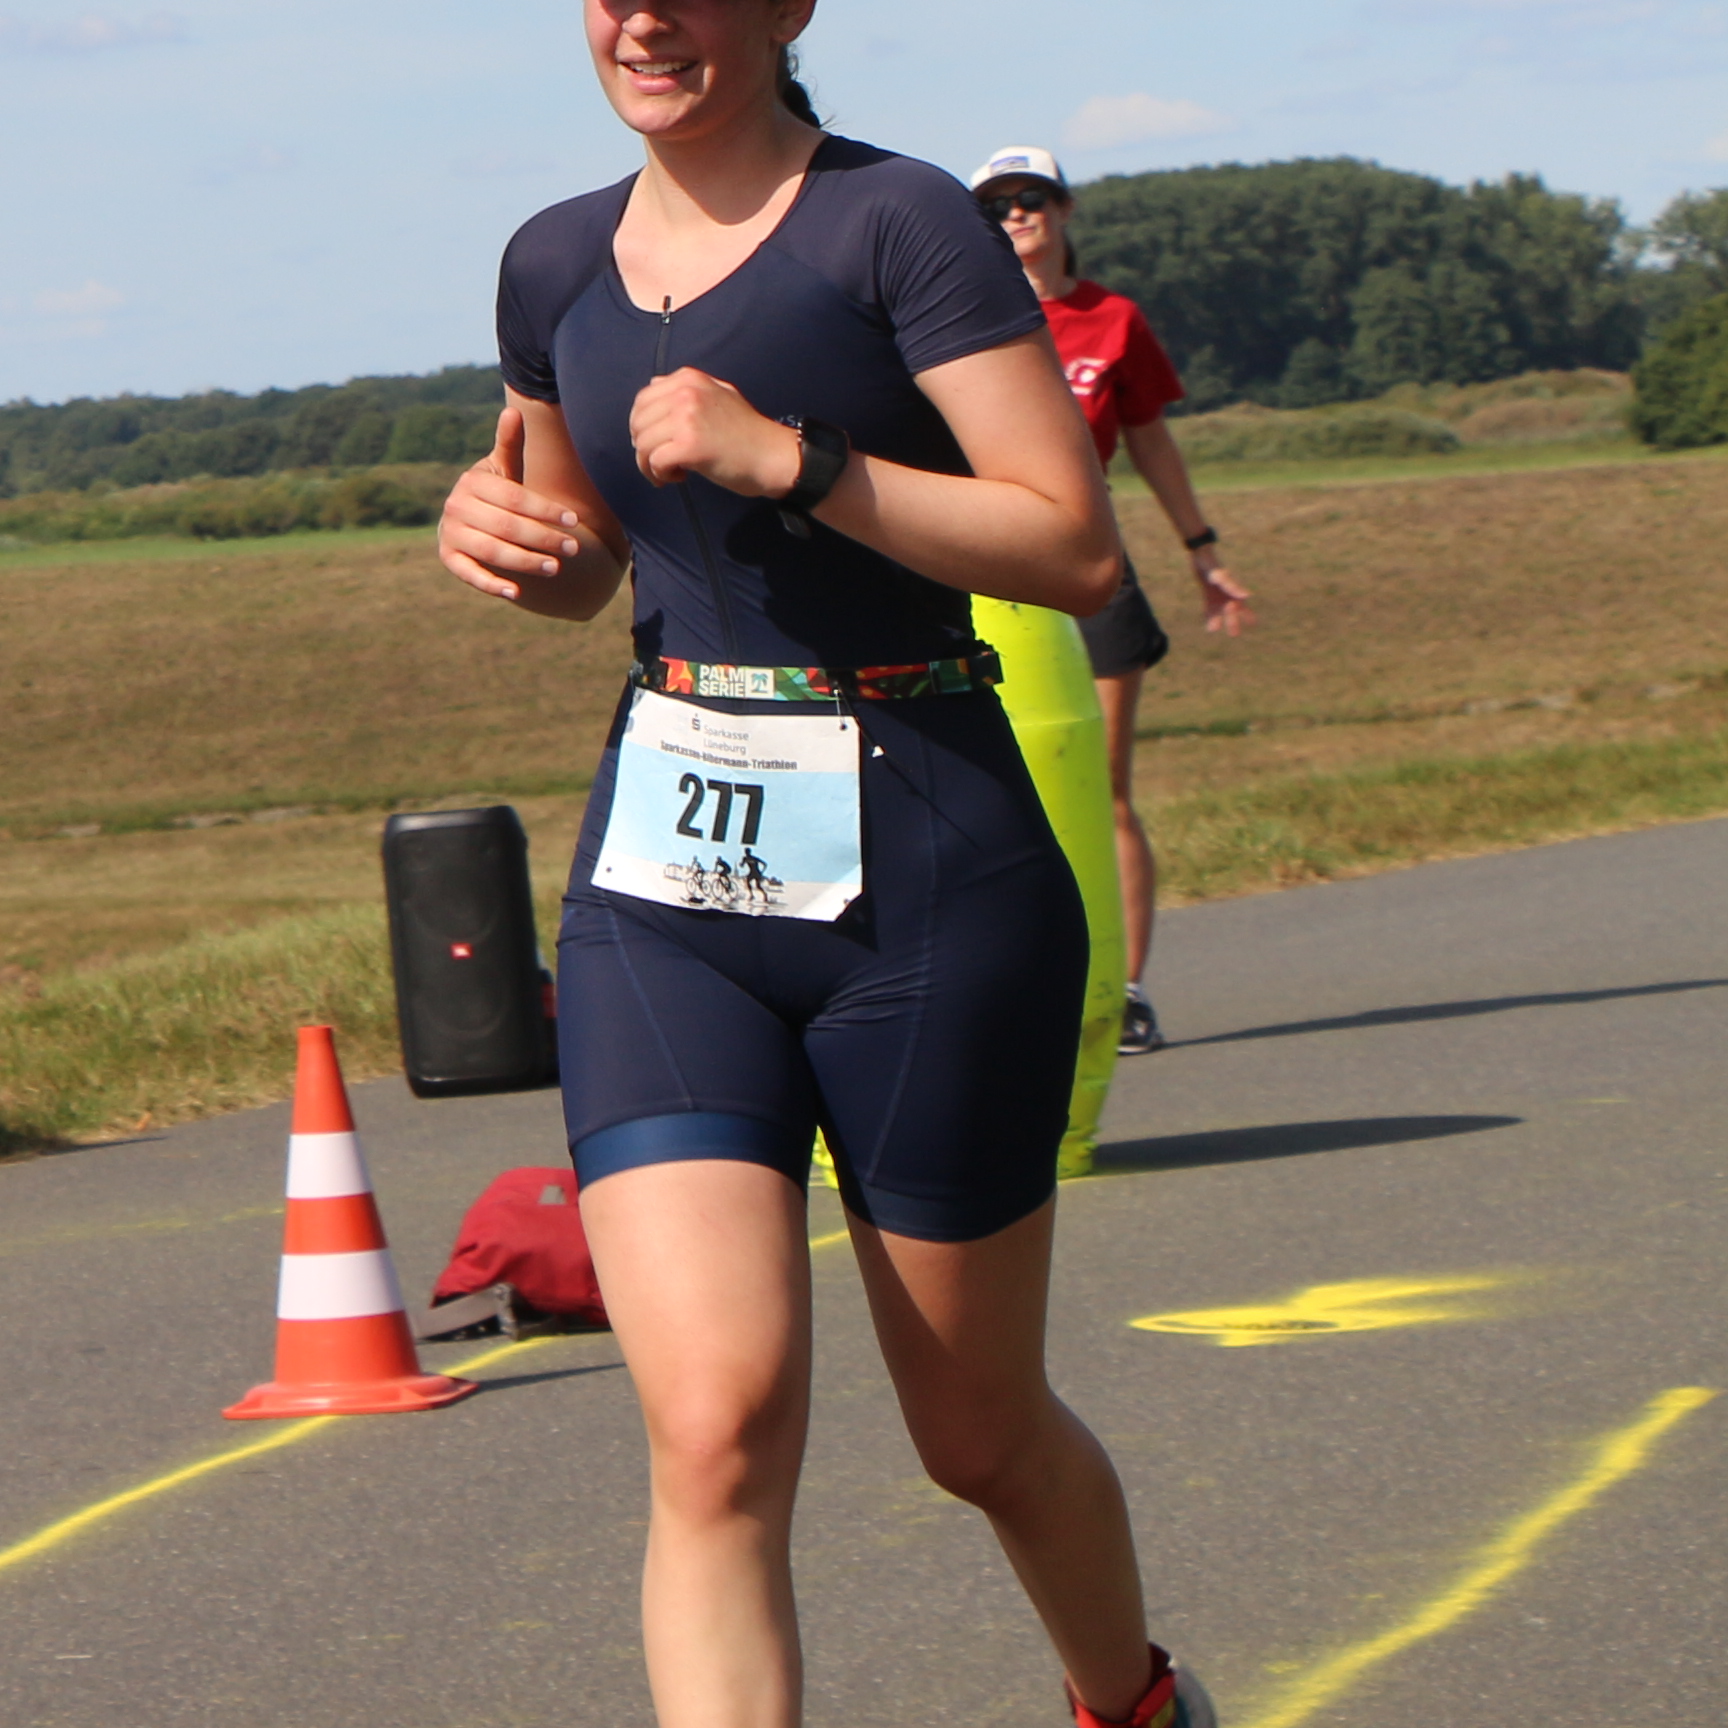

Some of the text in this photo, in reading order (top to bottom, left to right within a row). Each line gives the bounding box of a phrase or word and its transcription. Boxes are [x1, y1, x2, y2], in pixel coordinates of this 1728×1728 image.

[699, 664, 744, 682] PALM
[698, 680, 745, 697] SERIE
[704, 724, 749, 741] Sparkasse
[676, 772, 764, 845] 277
